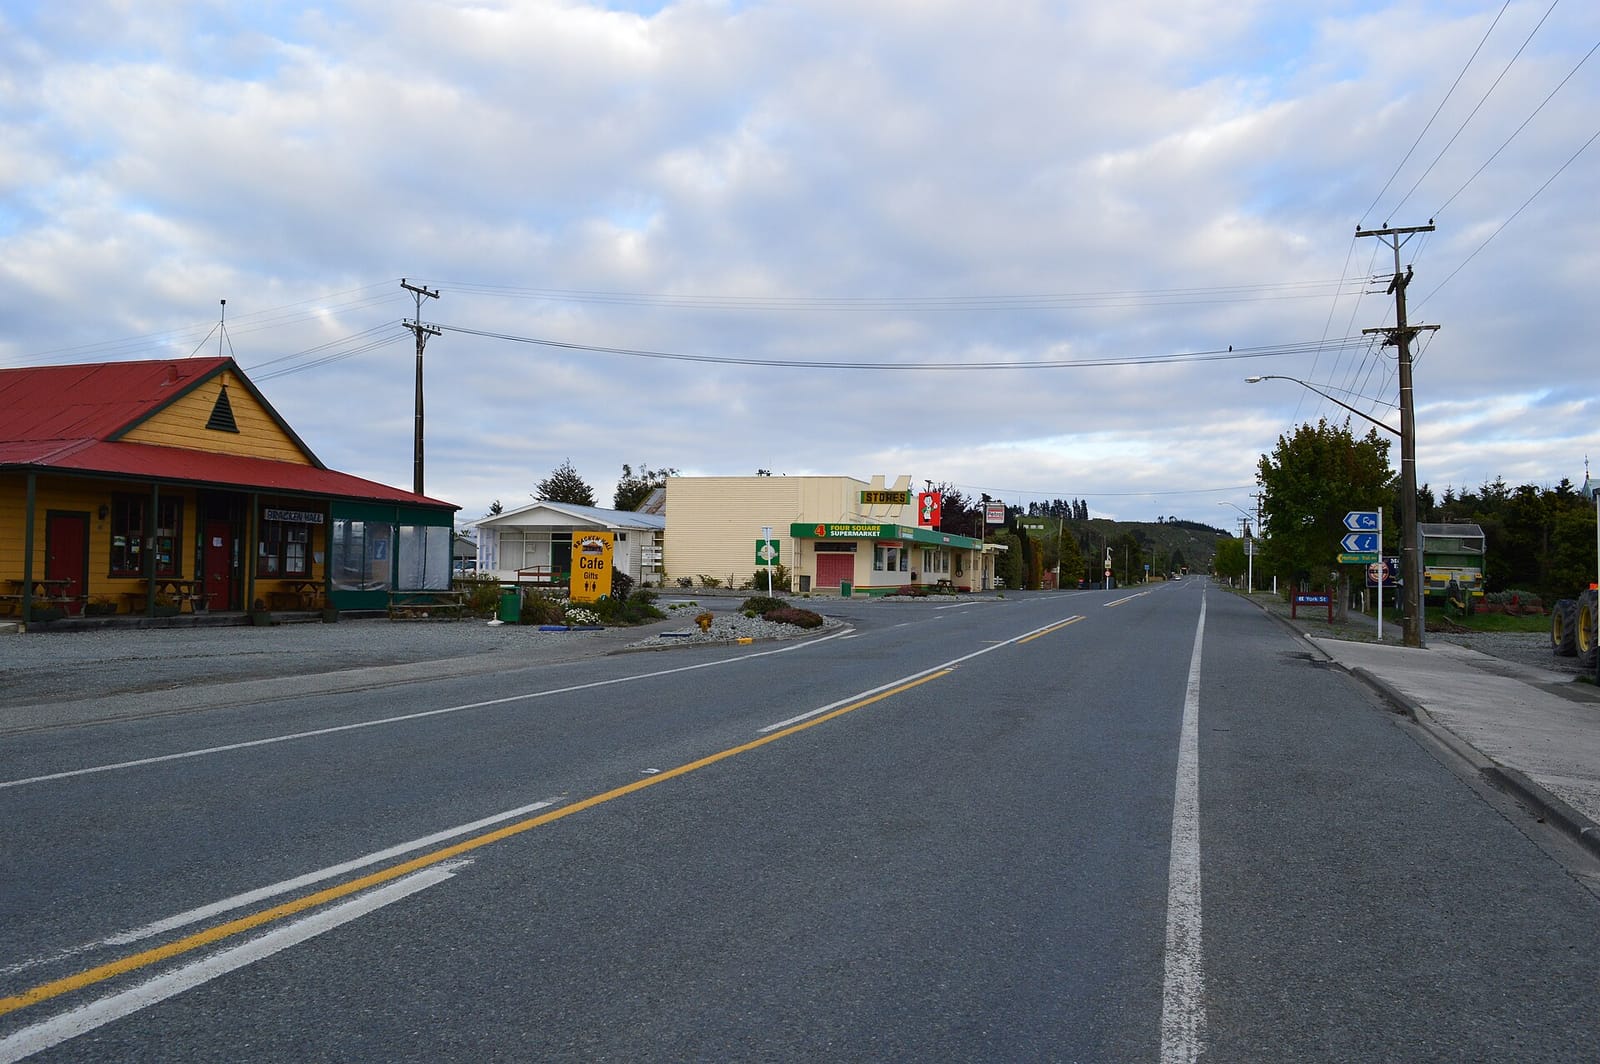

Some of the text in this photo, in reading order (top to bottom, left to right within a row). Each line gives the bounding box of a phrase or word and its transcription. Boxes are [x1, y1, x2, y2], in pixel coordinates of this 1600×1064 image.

[866, 492, 906, 503] STORES
[580, 556, 604, 569] Cafe
[583, 571, 599, 580] Gifts
